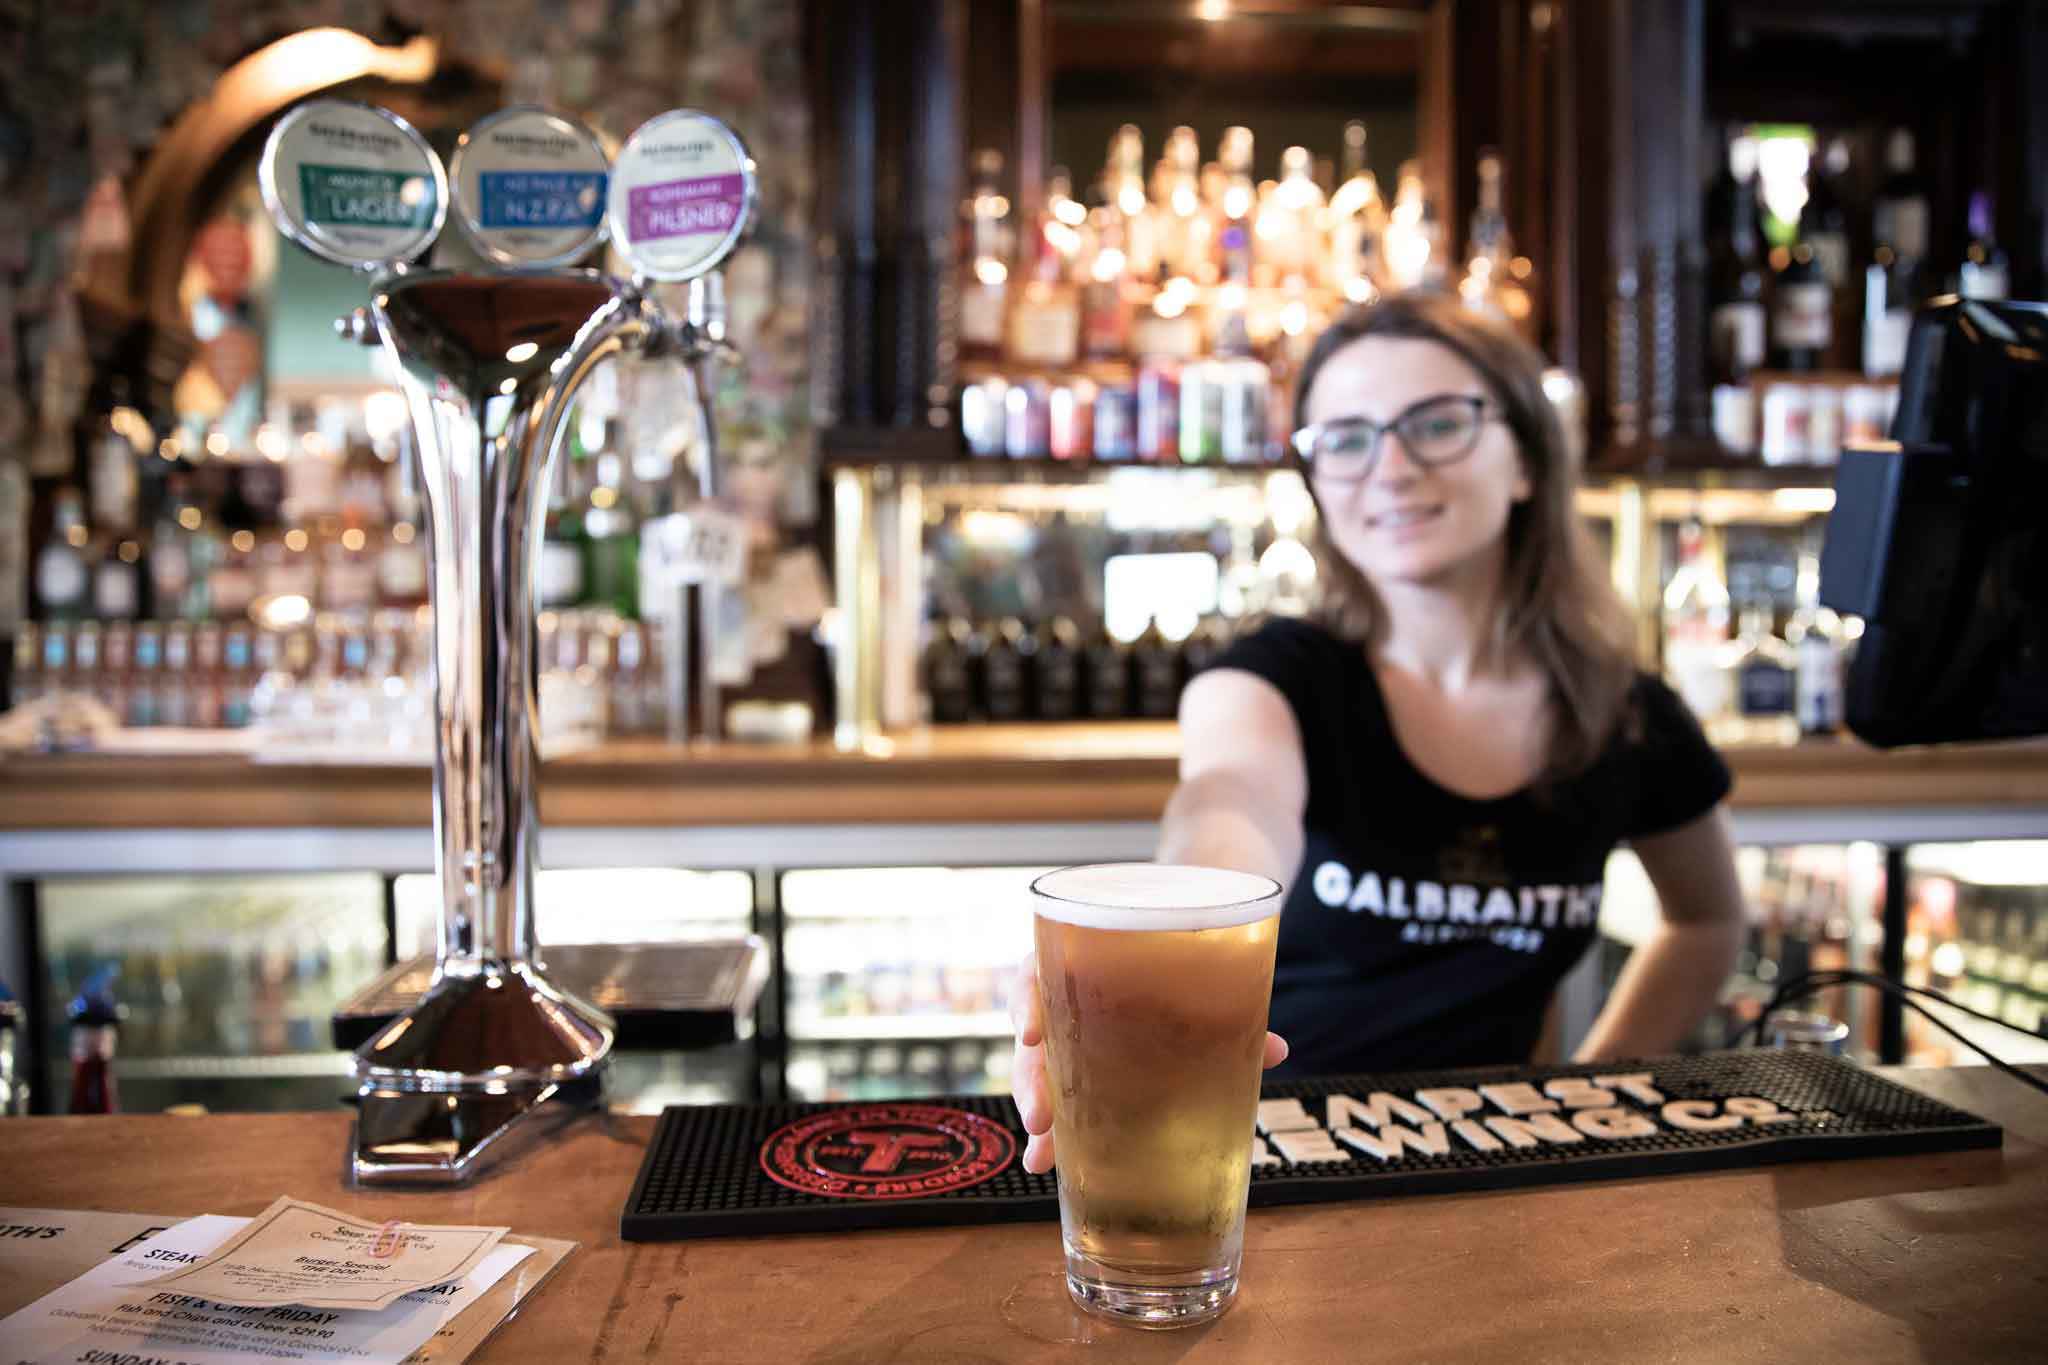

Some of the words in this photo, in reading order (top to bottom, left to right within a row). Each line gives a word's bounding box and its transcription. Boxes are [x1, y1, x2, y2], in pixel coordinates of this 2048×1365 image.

[650, 200, 736, 232] PILSNER
[1257, 1072, 1664, 1134] EMPEST
[1252, 1107, 1658, 1168] EWING
[144, 1248, 203, 1264] STEAK
[295, 1256, 340, 1266] Burger
[342, 1260, 392, 1271] Special
[115, 1303, 142, 1314] Fish
[143, 1308, 171, 1317] and
[173, 1311, 210, 1323] Chips
[212, 1317, 242, 1327] and
[242, 1321, 254, 1329] a
[254, 1322, 288, 1333] beer
[148, 1292, 191, 1308] FISH
[193, 1299, 208, 1308] &
[264, 1306, 339, 1324] FRIDAY
